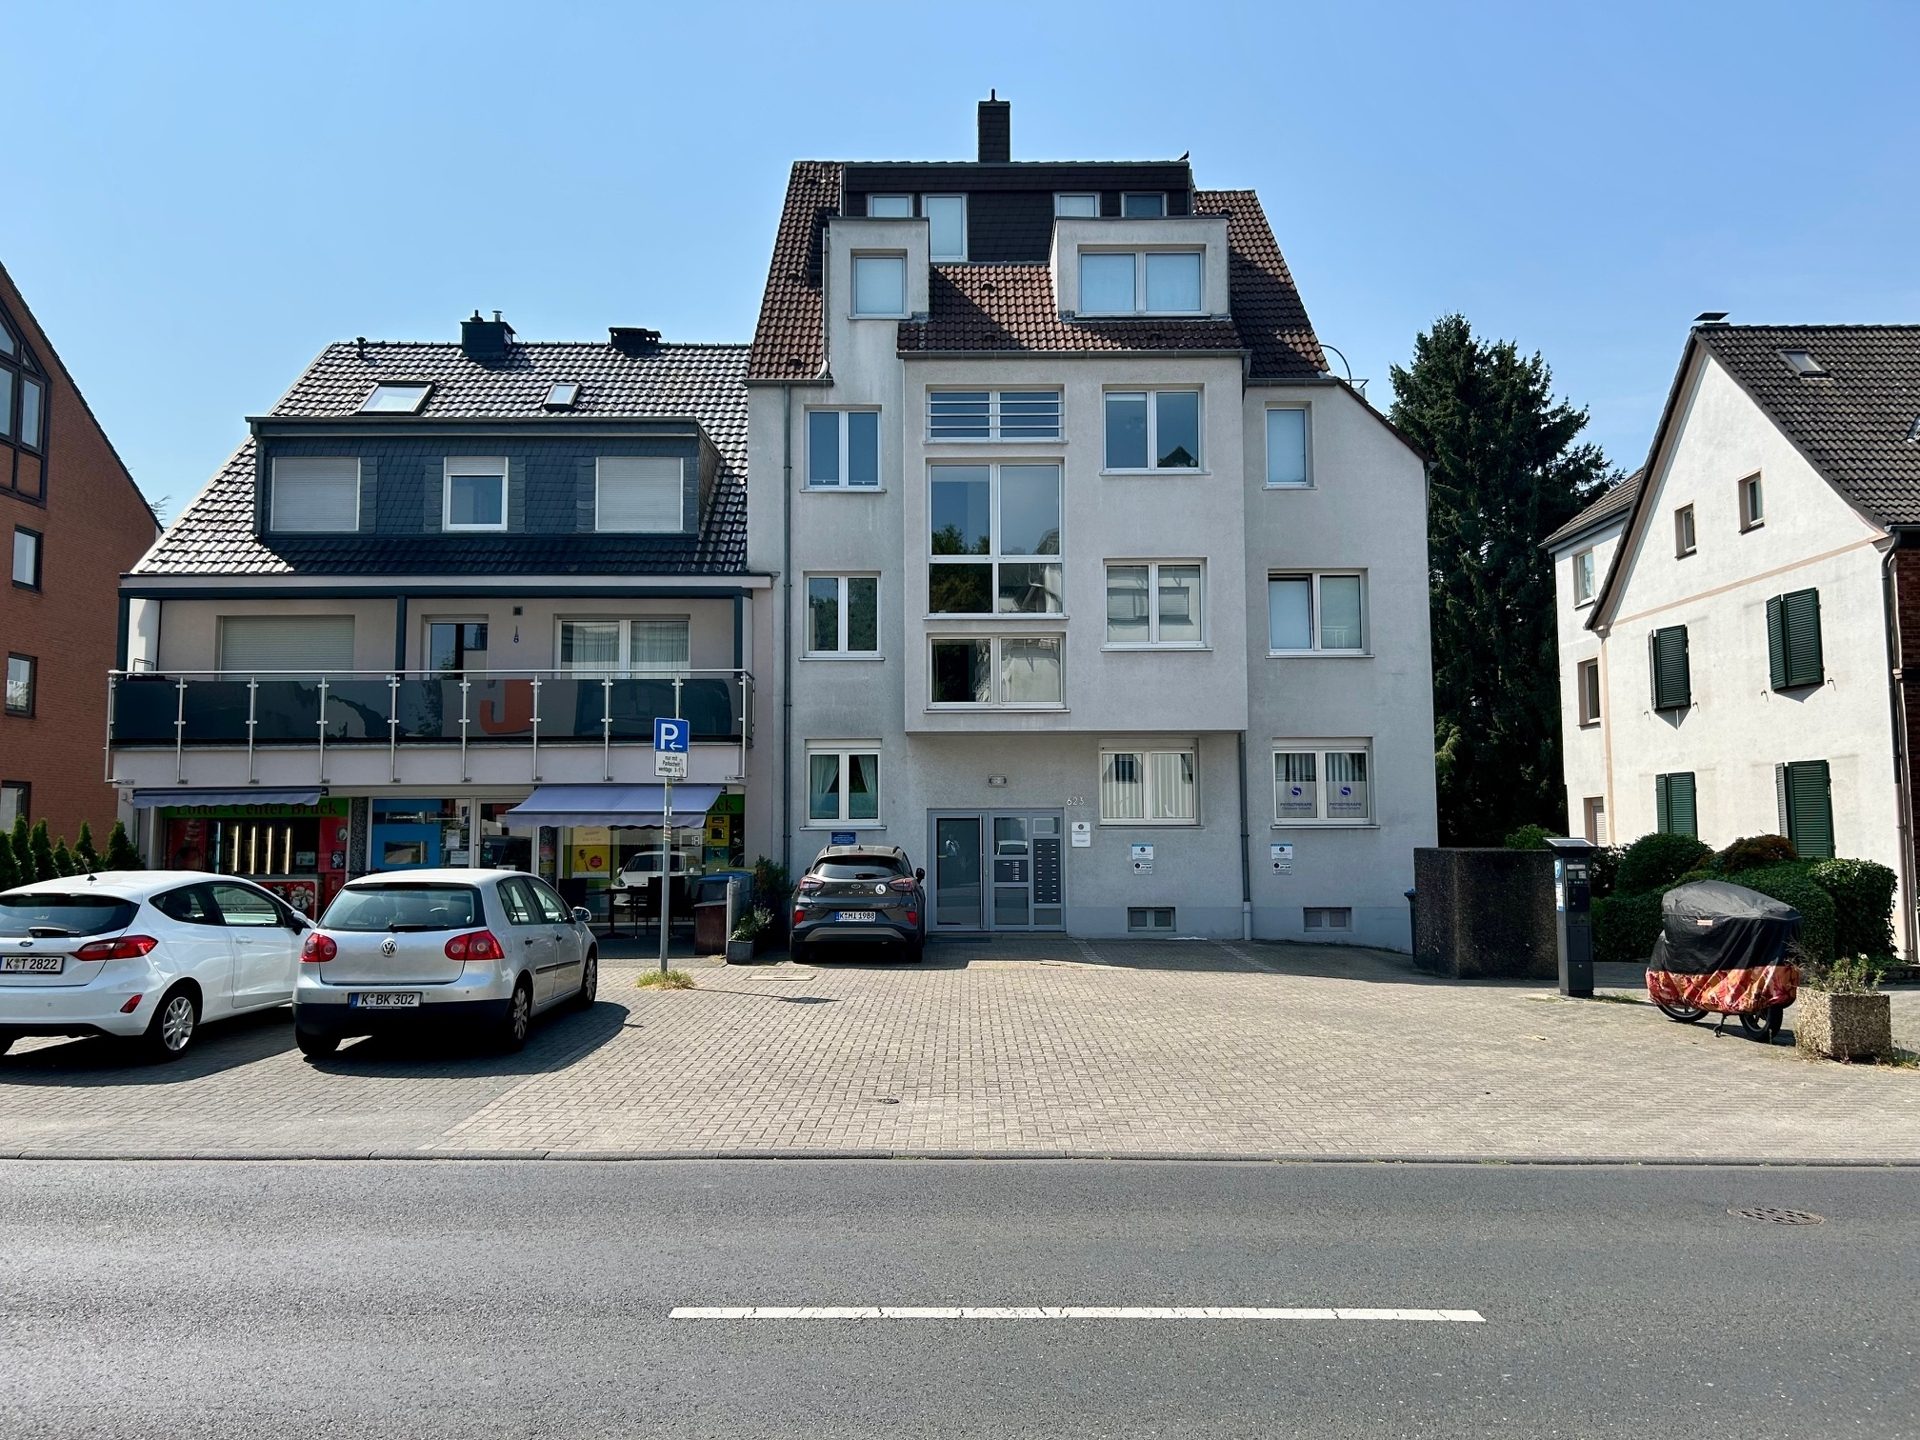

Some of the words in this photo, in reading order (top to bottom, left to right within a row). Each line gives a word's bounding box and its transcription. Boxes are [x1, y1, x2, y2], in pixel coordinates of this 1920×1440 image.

[660, 723, 679, 749] P
[1066, 796, 1085, 806] 623
[5, 958, 14, 970] K
[29, 958, 58, 970] 2822
[361, 994, 370, 1005] K
[375, 994, 391, 1005] BK
[393, 994, 415, 1005] 302
